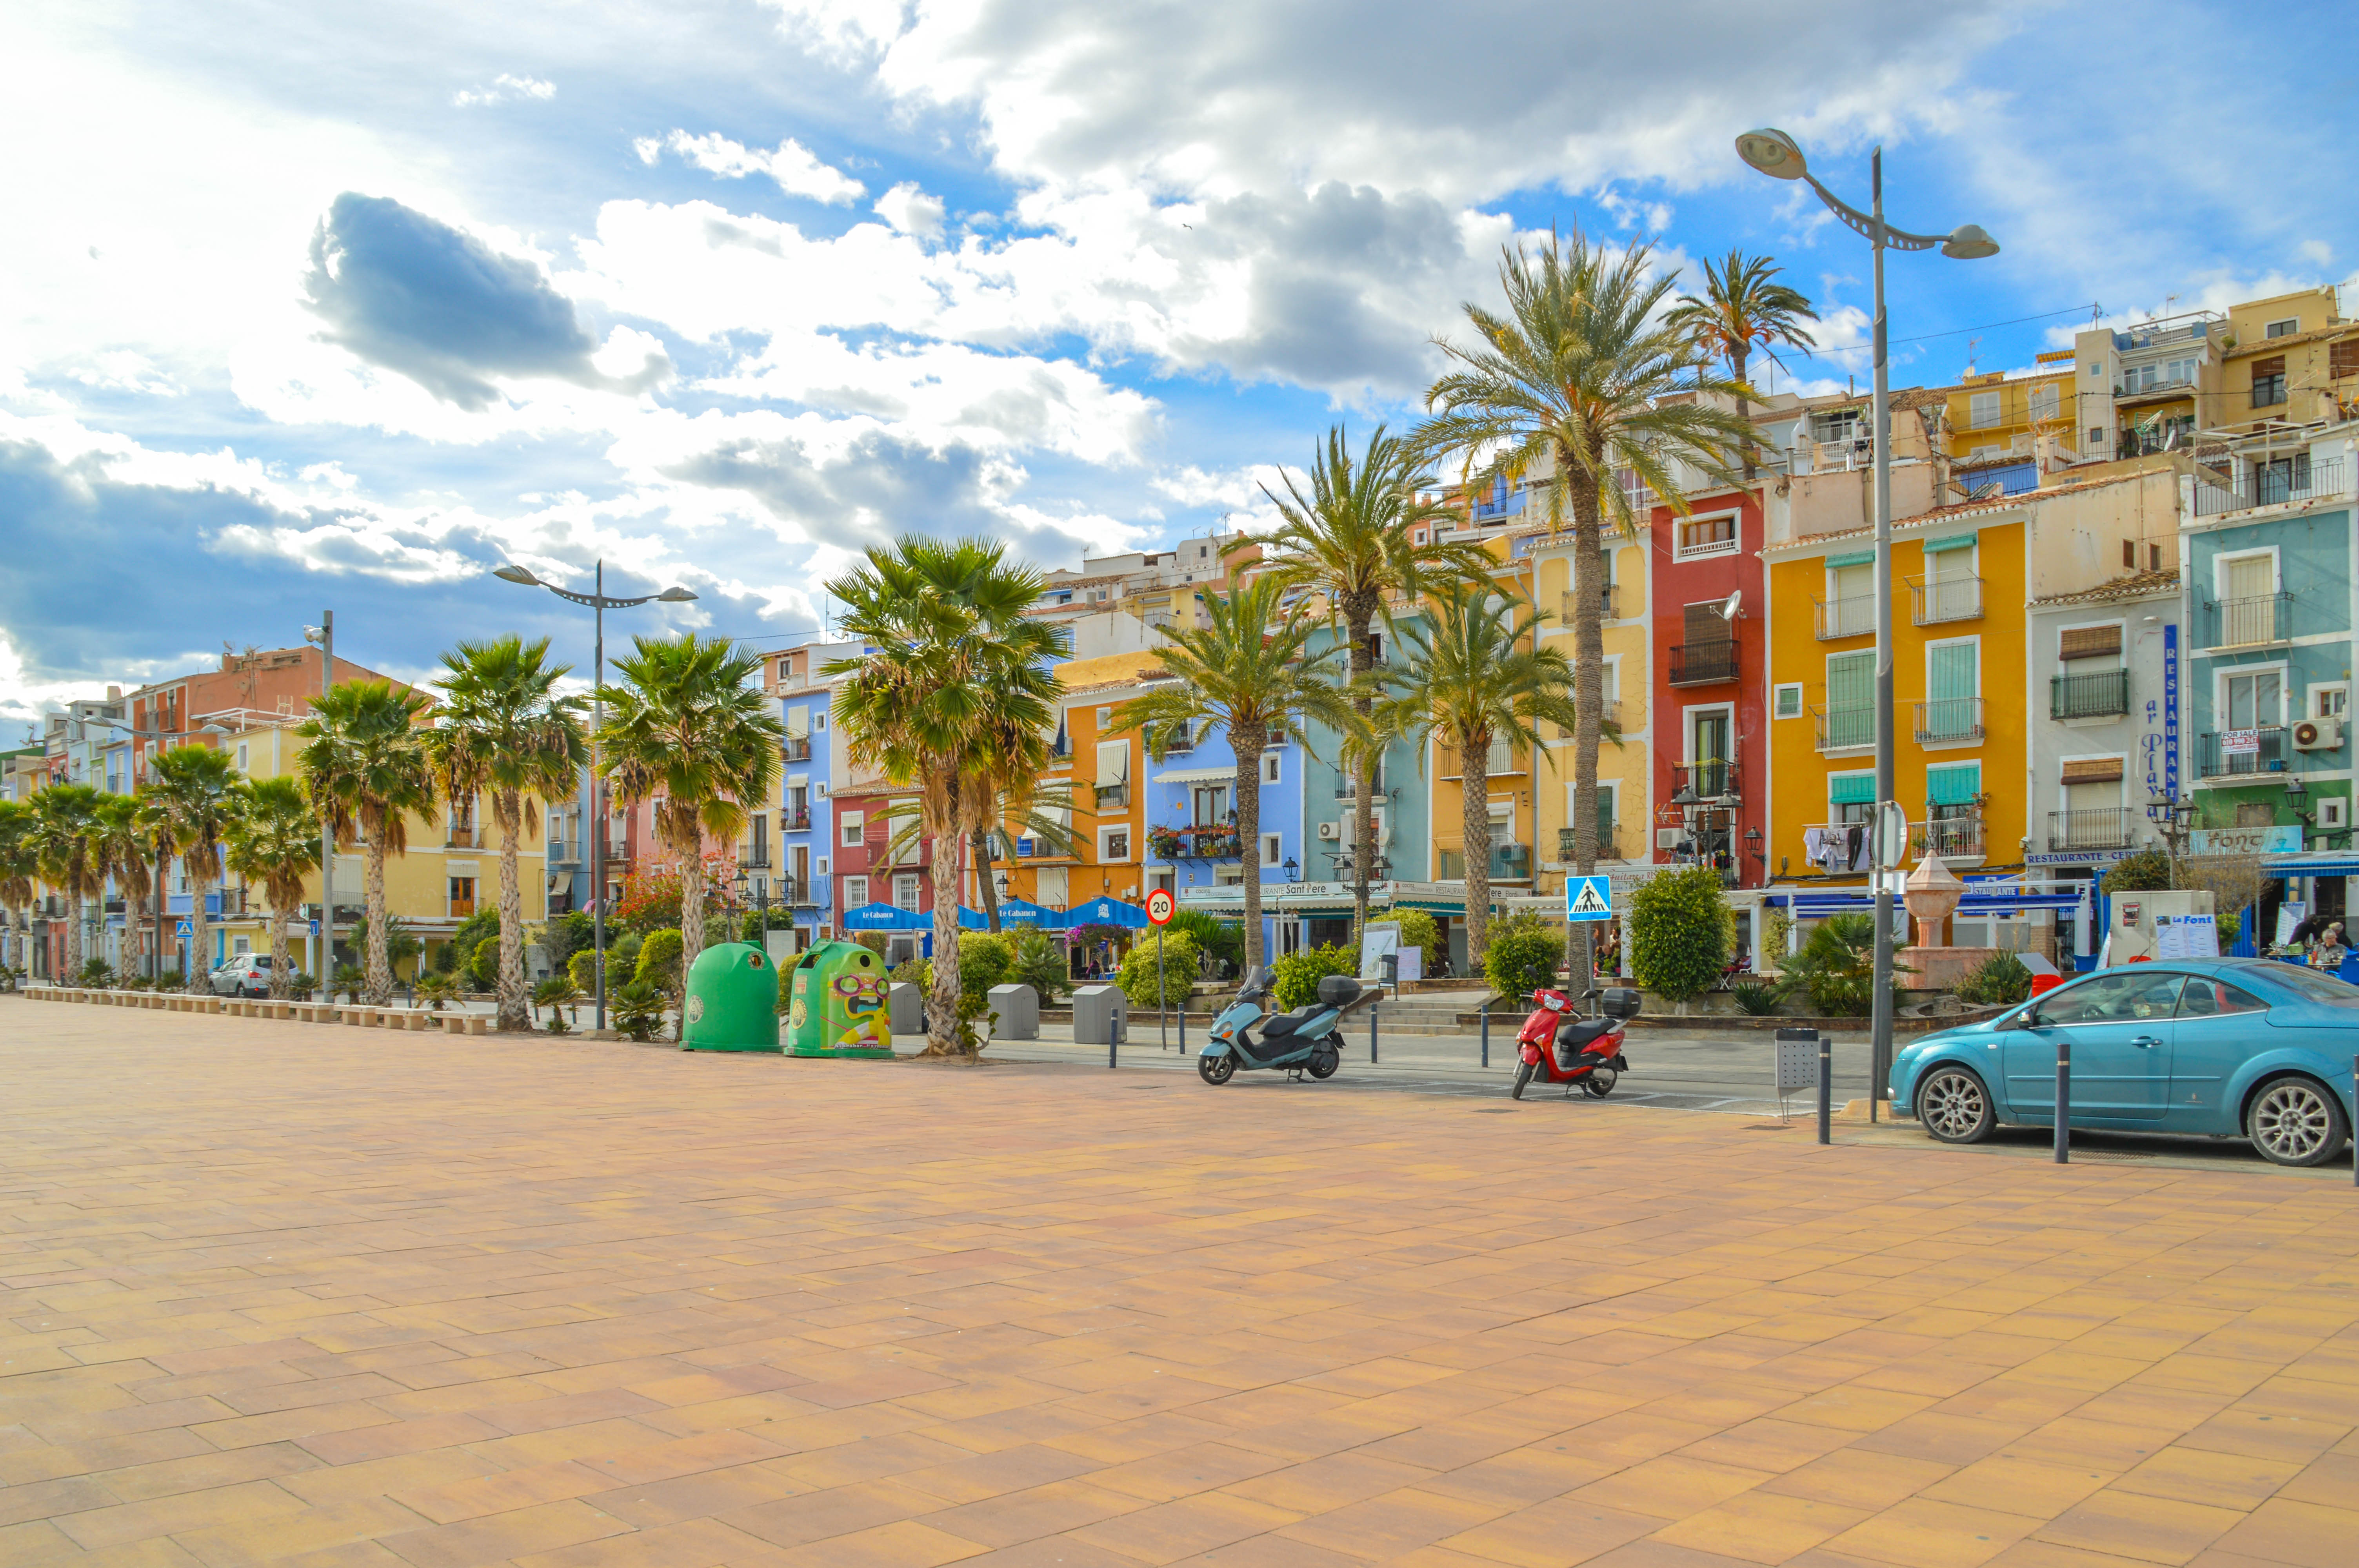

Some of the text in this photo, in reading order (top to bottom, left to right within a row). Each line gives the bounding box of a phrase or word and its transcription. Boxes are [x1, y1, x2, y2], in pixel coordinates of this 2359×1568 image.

[2028, 852, 2103, 863] RESTAURANTE
[1286, 885, 1305, 894] Sant
[1436, 886, 1467, 895] RESTAURANT
[1488, 889, 1502, 897] ere
[1153, 901, 1168, 913] 20
[2183, 916, 2212, 924] Font
